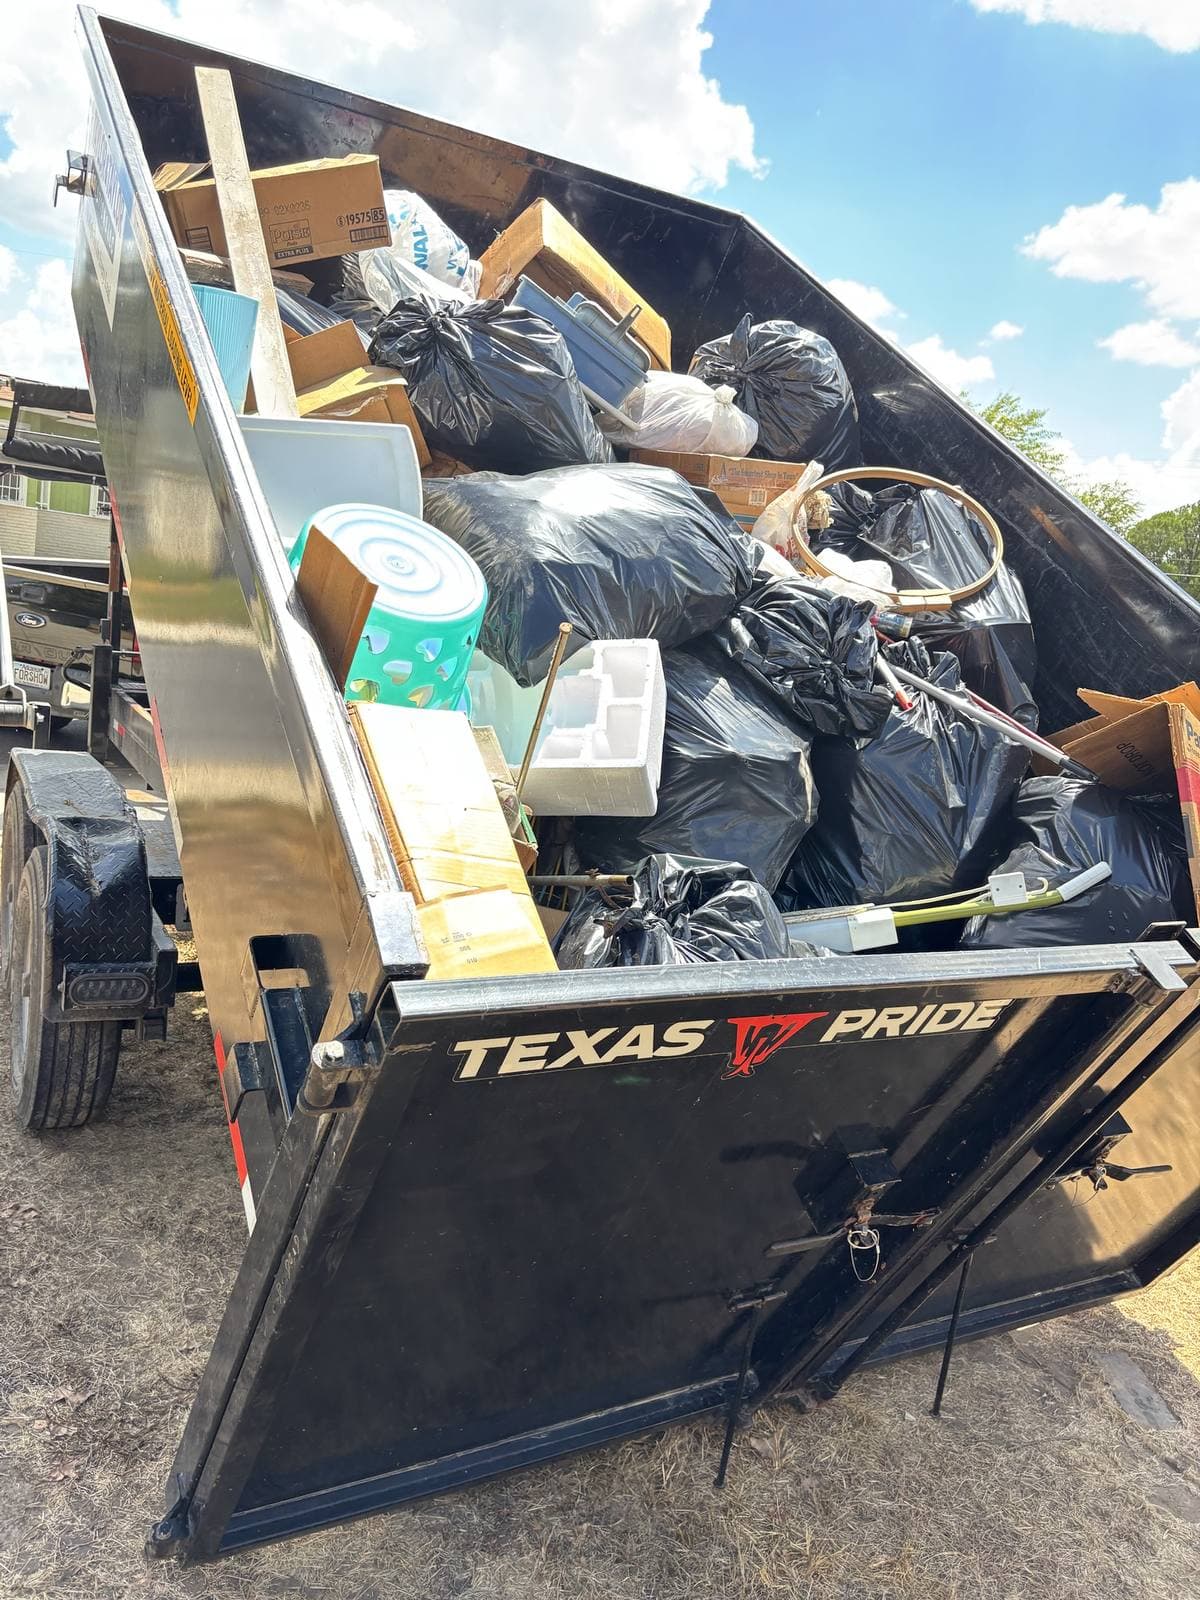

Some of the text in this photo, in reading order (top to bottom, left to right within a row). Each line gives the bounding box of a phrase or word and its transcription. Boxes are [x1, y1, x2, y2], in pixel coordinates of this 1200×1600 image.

[373, 209, 385, 221] 85
[277, 247, 310, 258] EXTRA PLUS
[180, 368, 193, 412] LEVEL
[14, 668, 48, 685] FORSHOW
[453, 998, 1011, 1079] TEXAS PRIDE
